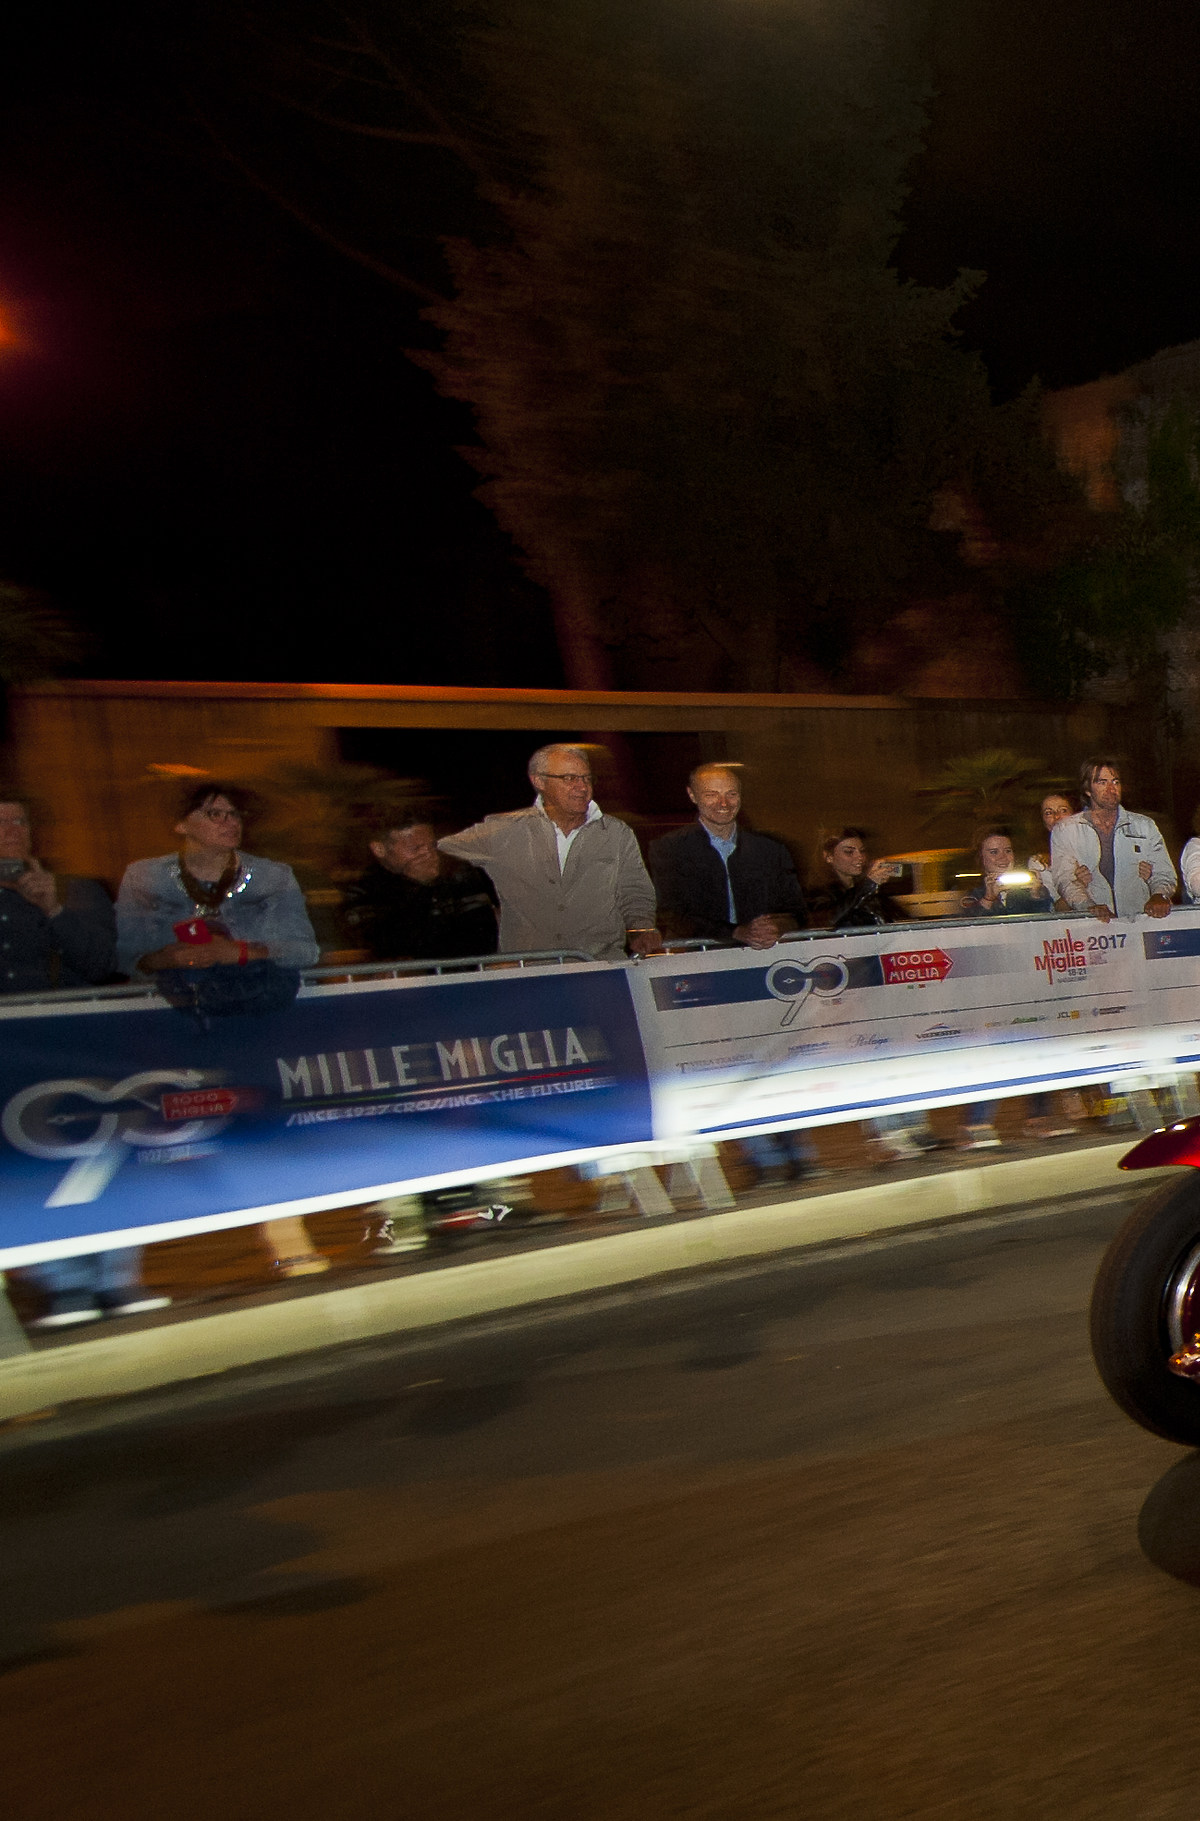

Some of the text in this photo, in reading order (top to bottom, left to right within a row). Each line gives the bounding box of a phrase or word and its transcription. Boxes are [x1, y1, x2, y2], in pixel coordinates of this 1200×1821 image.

[1043, 928, 1127, 954] Mille 2017
[888, 953, 935, 967] 1000
[1034, 951, 1087, 985] Miglia
[889, 966, 941, 982] MIGLIA
[277, 1027, 590, 1099] MILLE MIGLIA
